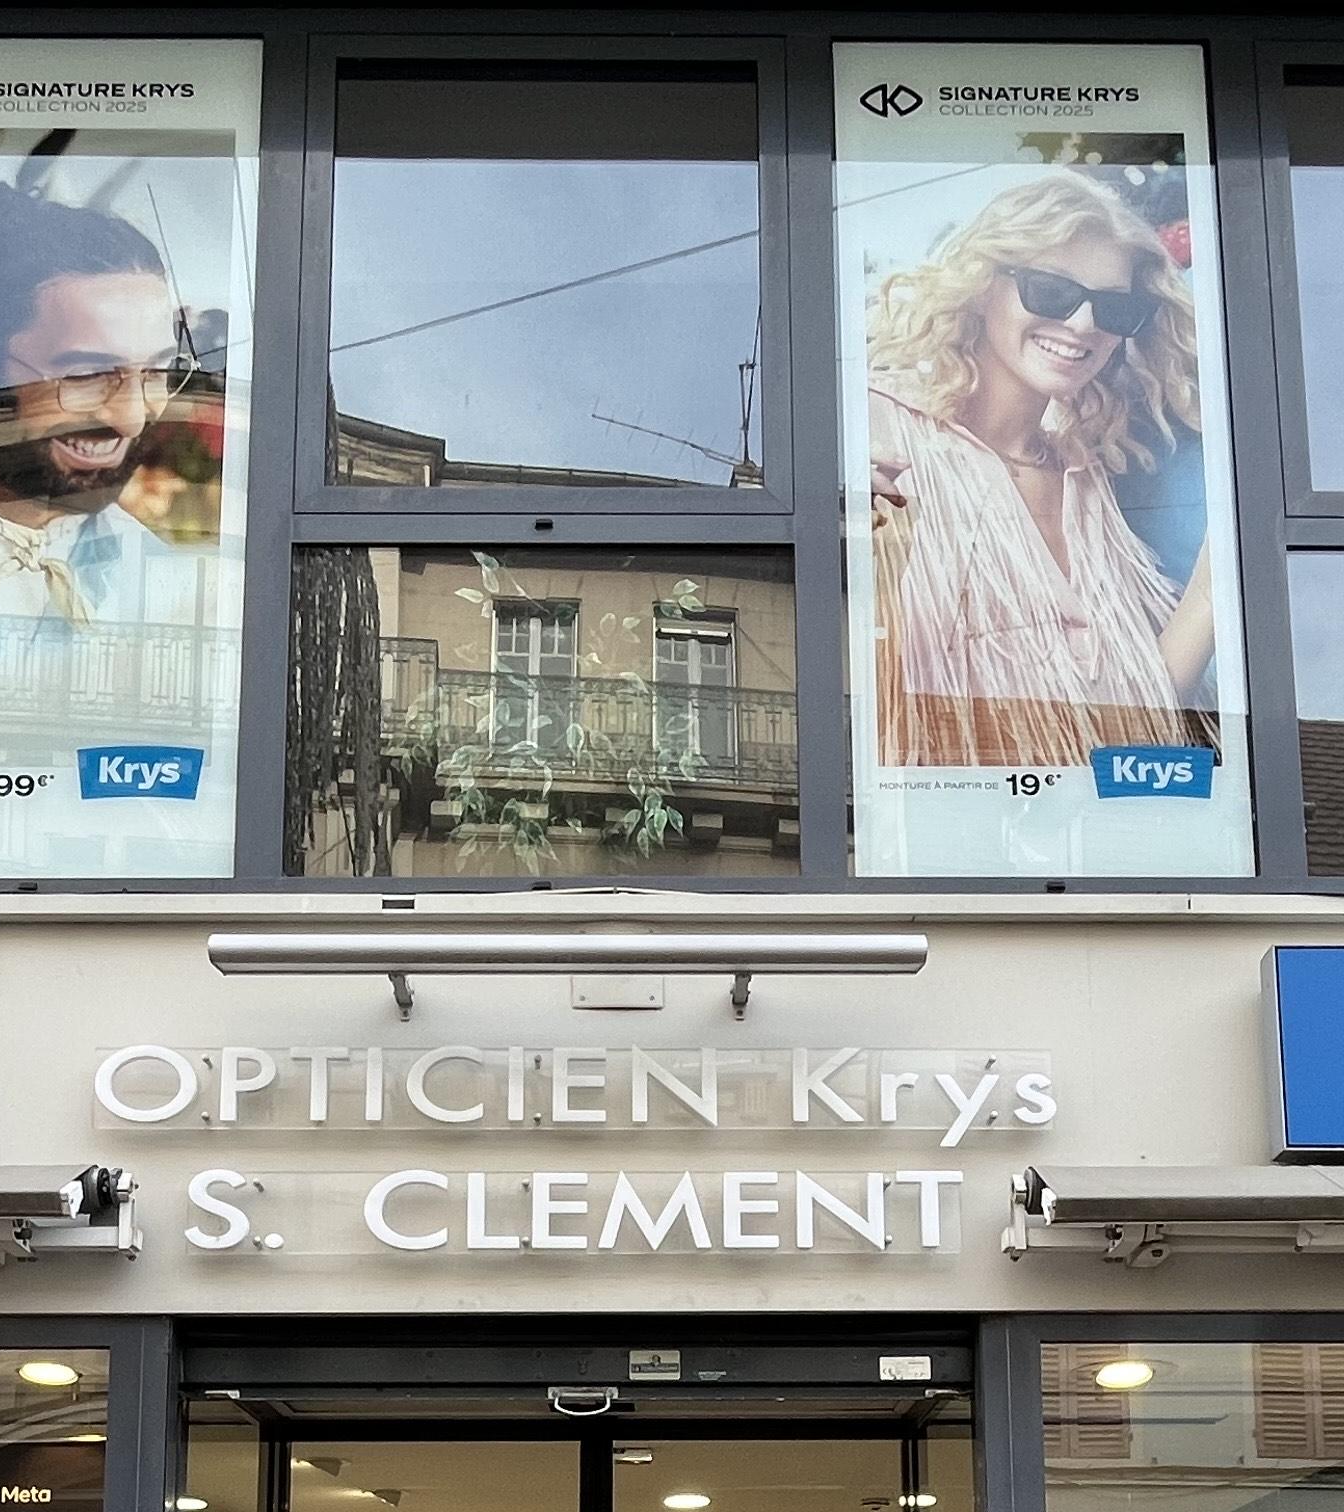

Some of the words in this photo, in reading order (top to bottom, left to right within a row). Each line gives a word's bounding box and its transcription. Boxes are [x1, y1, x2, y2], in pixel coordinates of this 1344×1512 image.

[133, 83, 194, 98] KRYS
[939, 87, 1070, 101] SIGNATURE
[1079, 88, 1139, 101] KRYS
[106, 102, 147, 112] 2025
[939, 105, 1048, 116] COLLECTION
[1053, 105, 1093, 116] 2025
[99, 756, 180, 790] Krys
[1112, 756, 1192, 789] Krys
[880, 782, 931, 790] MONTURE
[934, 780, 941, 790] À
[944, 782, 982, 790] PARTIR
[985, 782, 999, 790] DE
[93, 1045, 716, 1128] OPTICIEN
[791, 1046, 1057, 1148] Krys
[184, 1169, 285, 1250] S.
[363, 1168, 963, 1251] CLEMENT
[1, 1486, 51, 1503] Meta
